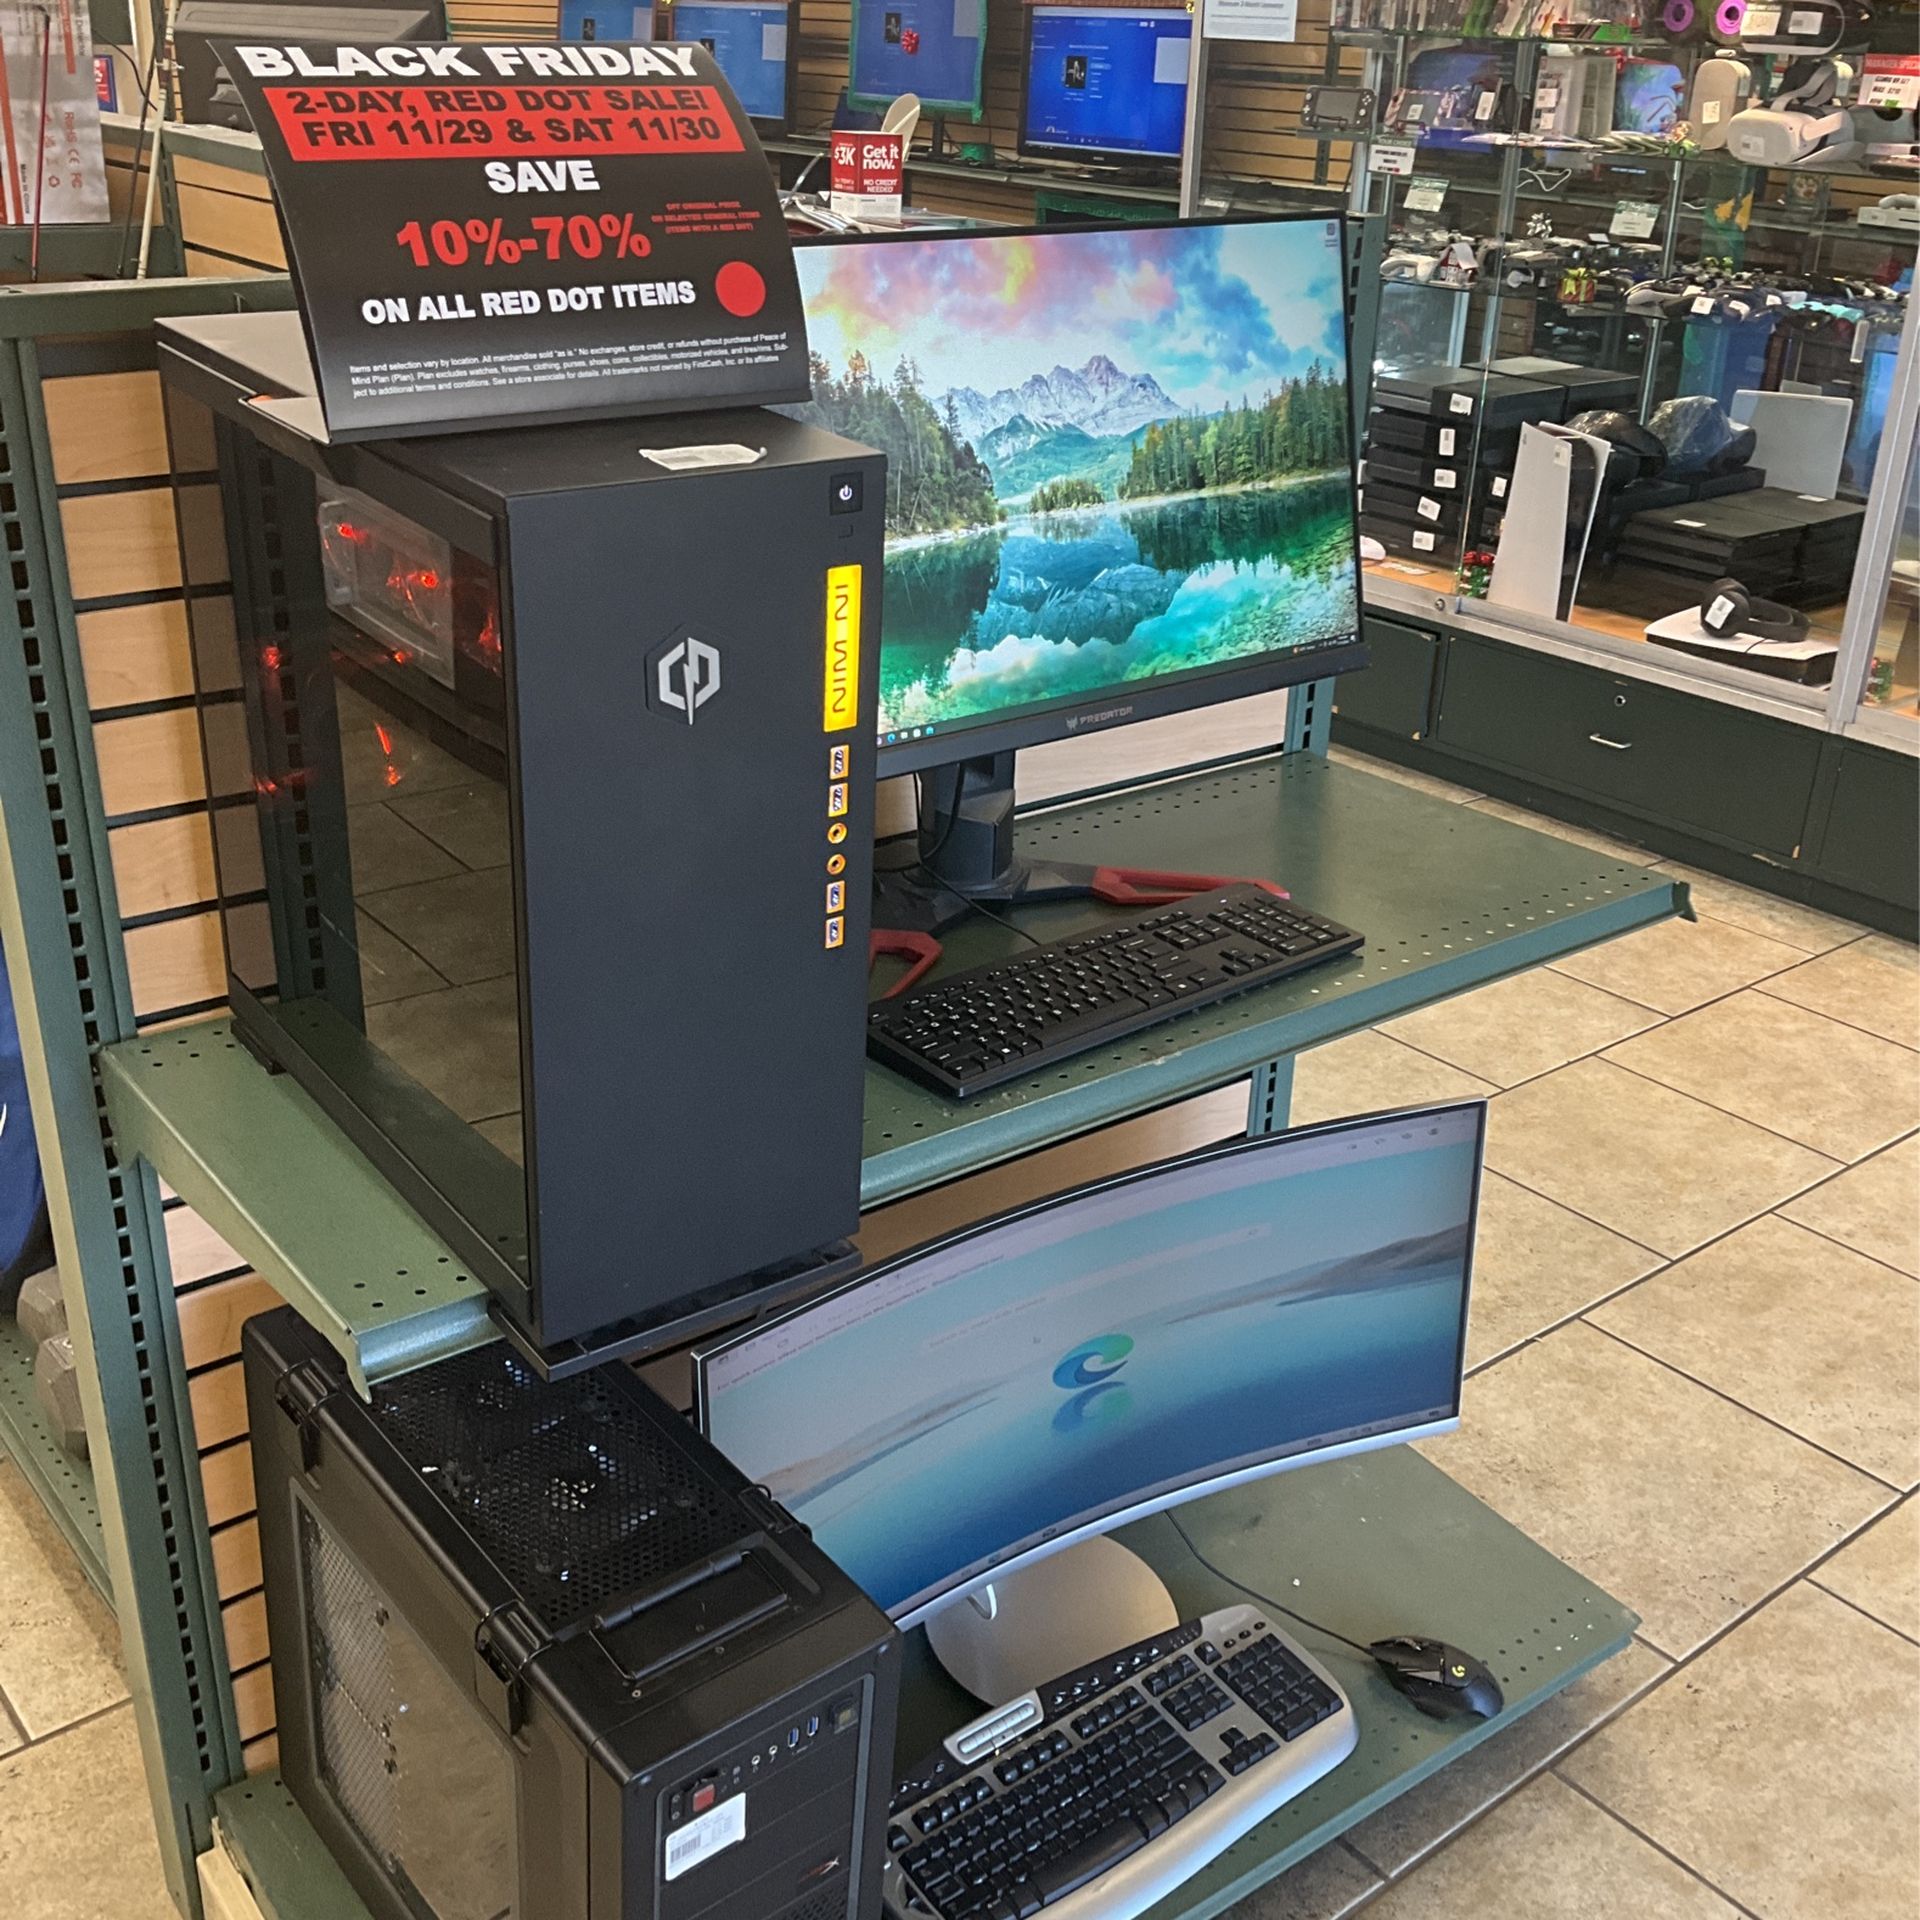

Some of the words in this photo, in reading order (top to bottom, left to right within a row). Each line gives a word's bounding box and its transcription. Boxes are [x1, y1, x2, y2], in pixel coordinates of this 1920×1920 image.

[235, 46, 481, 77] BLACK
[495, 46, 701, 76] FRIDAY
[288, 91, 419, 117] 2-DAY,
[425, 90, 508, 112] RED
[516, 89, 591, 111] DOT
[604, 89, 708, 111] SALE!
[302, 121, 376, 147] FRI
[387, 119, 494, 145] 11/29
[506, 119, 536, 143] &
[545, 118, 614, 143] SAT
[629, 117, 721, 140] 11/30
[834, 145, 856, 166] $3K
[863, 144, 888, 159] Get
[890, 143, 900, 159] it
[863, 158, 895, 169] now.
[485, 160, 600, 193] SAVE
[397, 214, 651, 266] 10%-70%
[362, 298, 410, 324] ON
[419, 295, 476, 320] ALL
[481, 290, 541, 316] RED
[547, 286, 604, 312] DOT
[612, 281, 695, 308] ITEMS
[1080, 706, 1134, 725] PREDATOR
